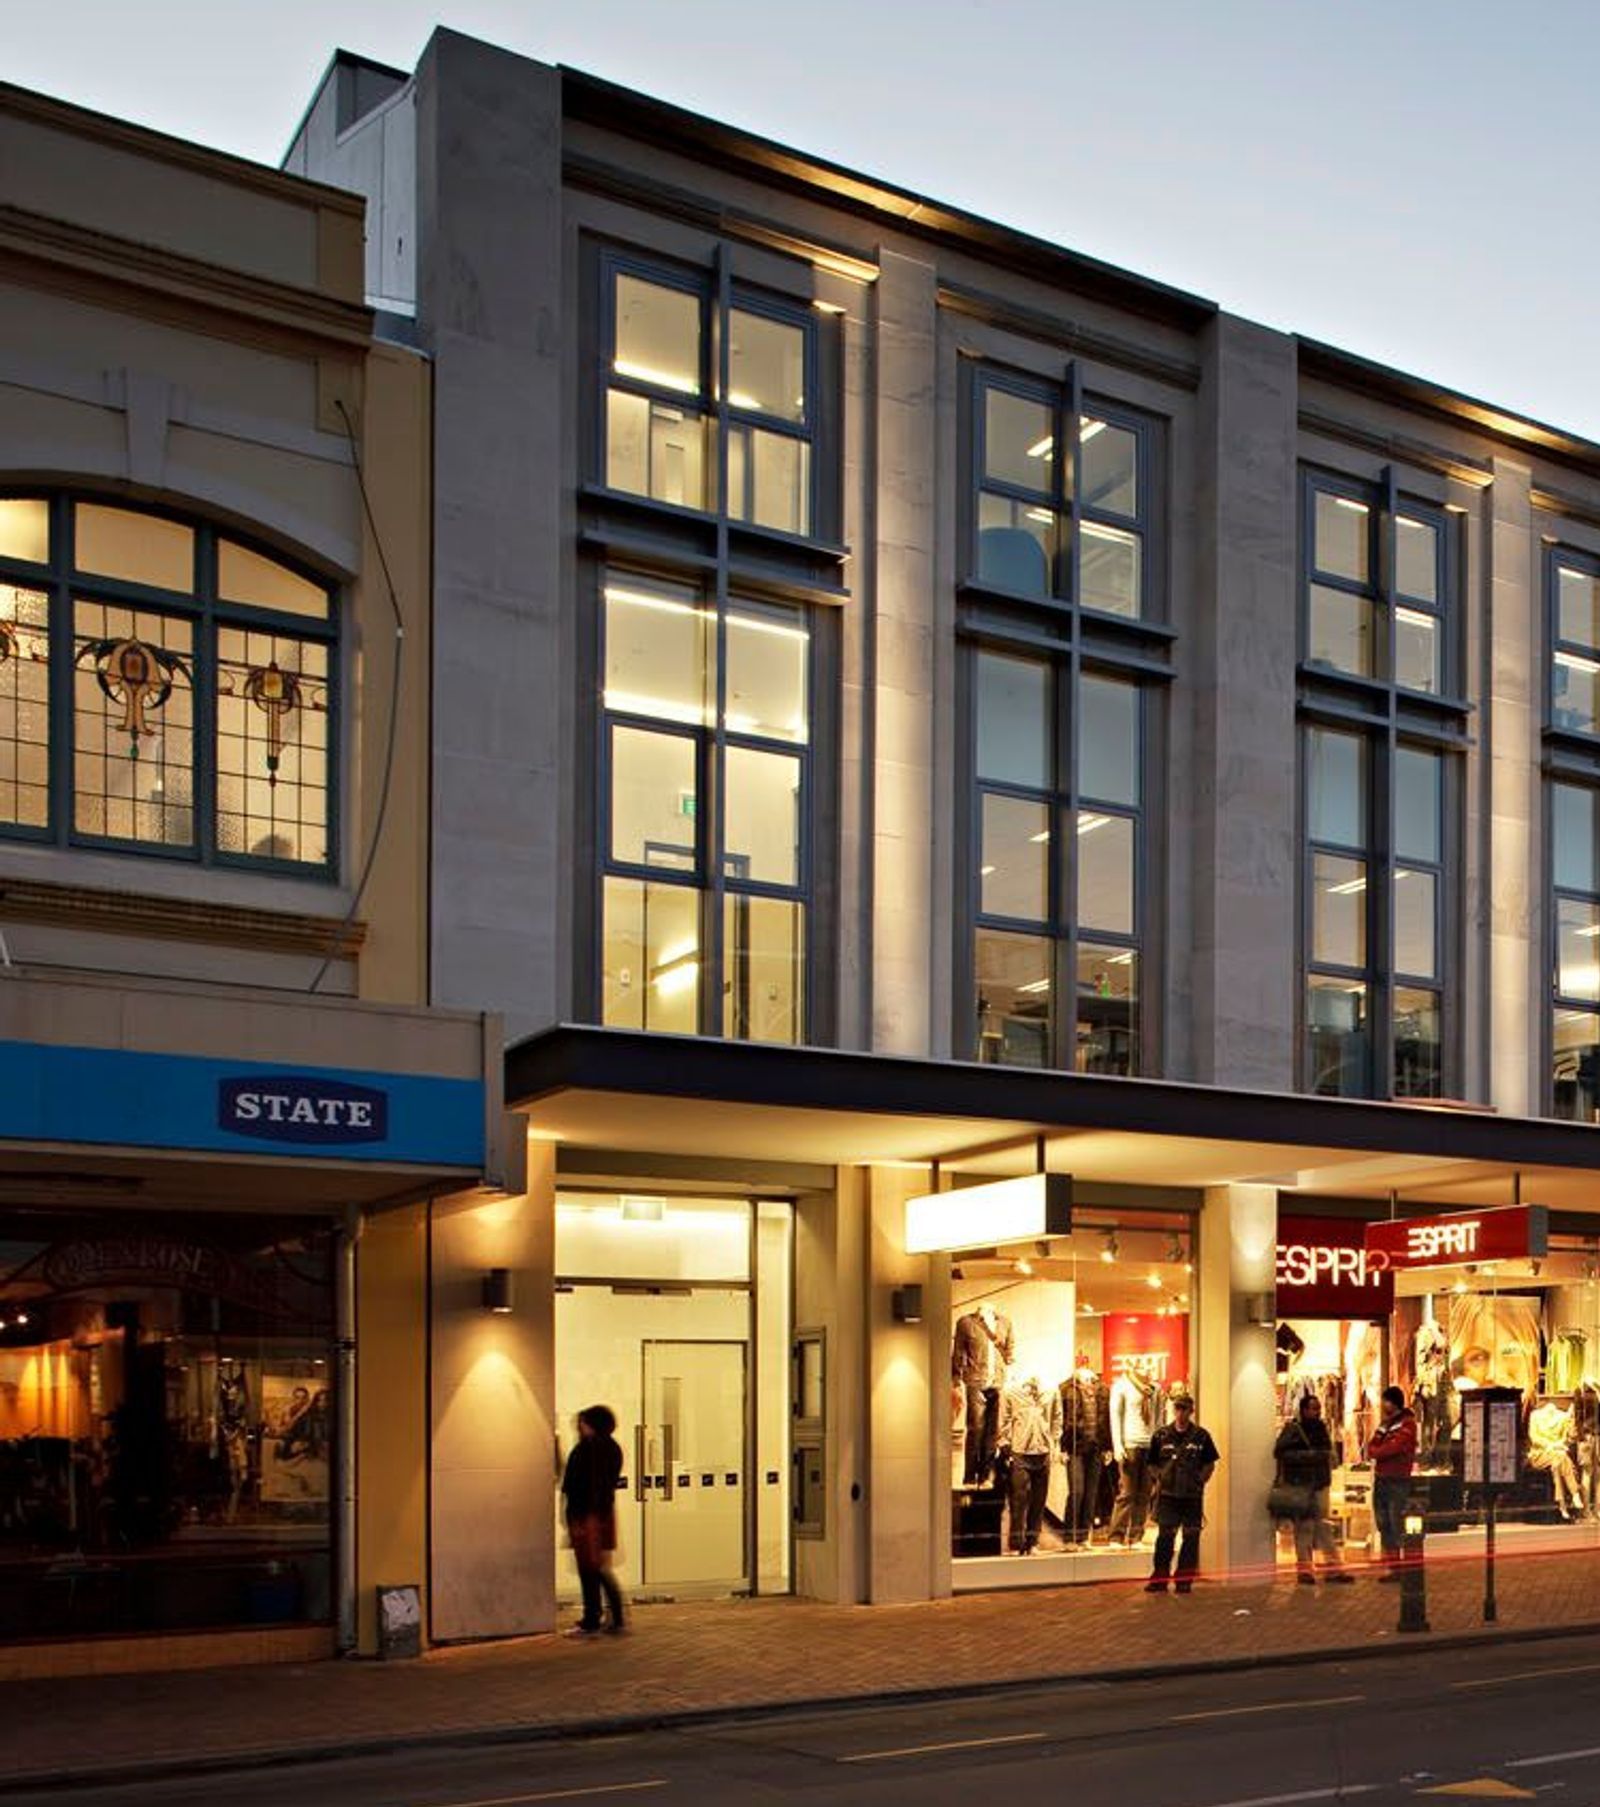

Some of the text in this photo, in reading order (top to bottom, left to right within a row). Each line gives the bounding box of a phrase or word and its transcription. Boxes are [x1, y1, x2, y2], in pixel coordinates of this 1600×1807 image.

[235, 1093, 372, 1127] STATE
[1408, 1222, 1480, 1258] ESPRIT
[1276, 1245, 1381, 1287] ESPRI
